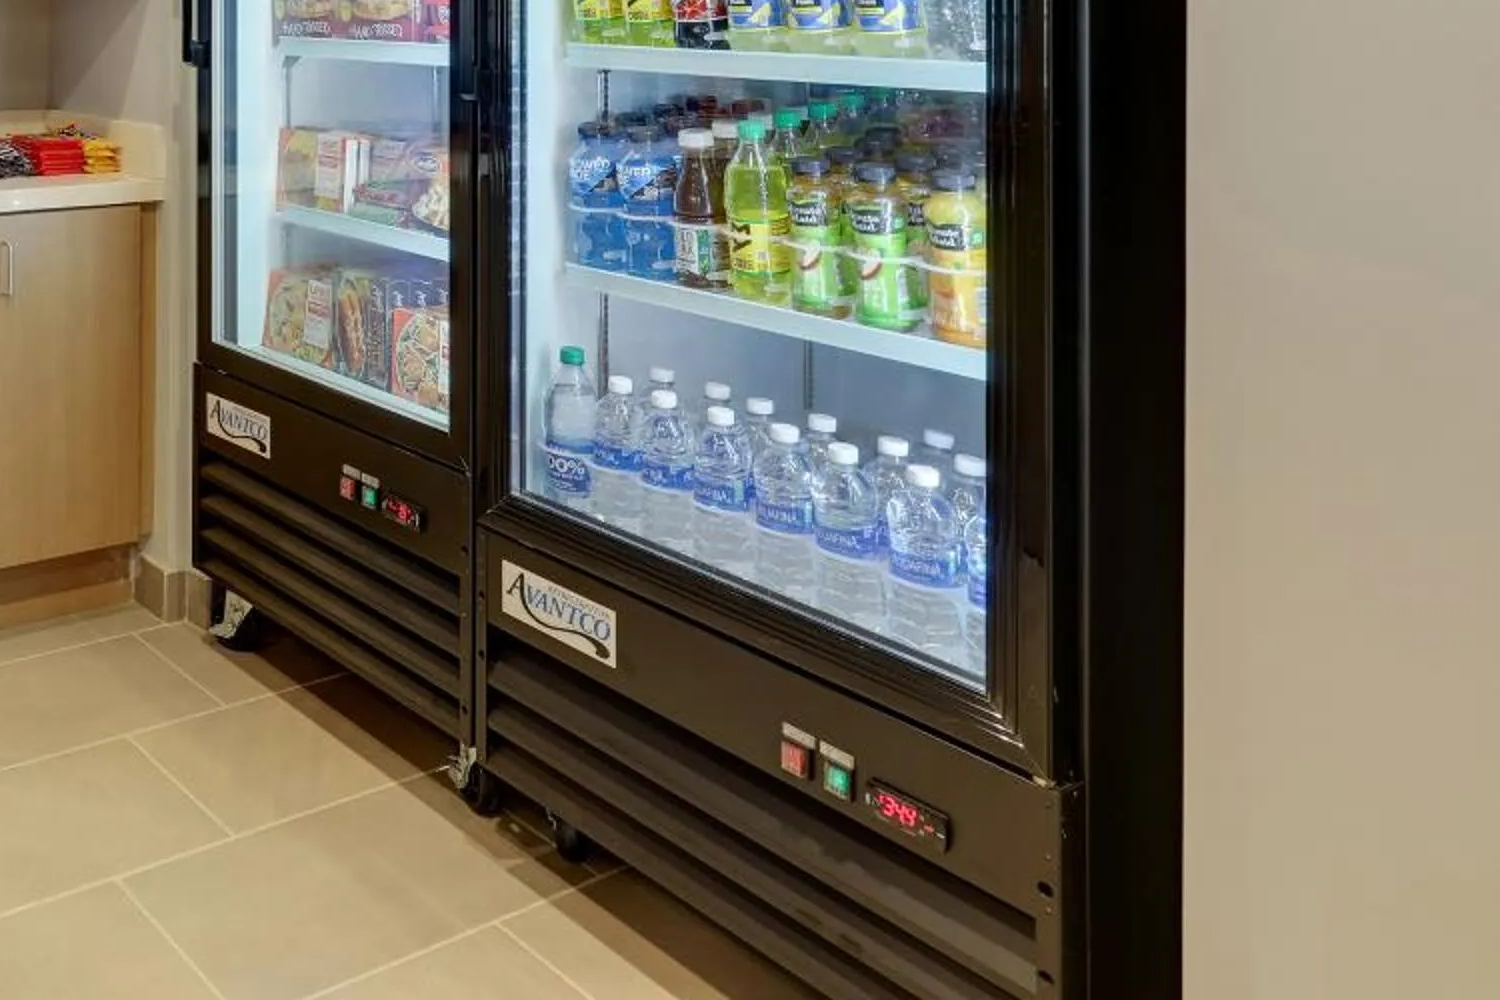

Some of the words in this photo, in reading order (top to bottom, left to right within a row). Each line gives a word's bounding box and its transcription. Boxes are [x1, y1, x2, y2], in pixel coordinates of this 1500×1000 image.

[210, 399, 268, 442] AVANTCO
[549, 456, 585, 476] 00%
[506, 572, 611, 642] AVANTCO
